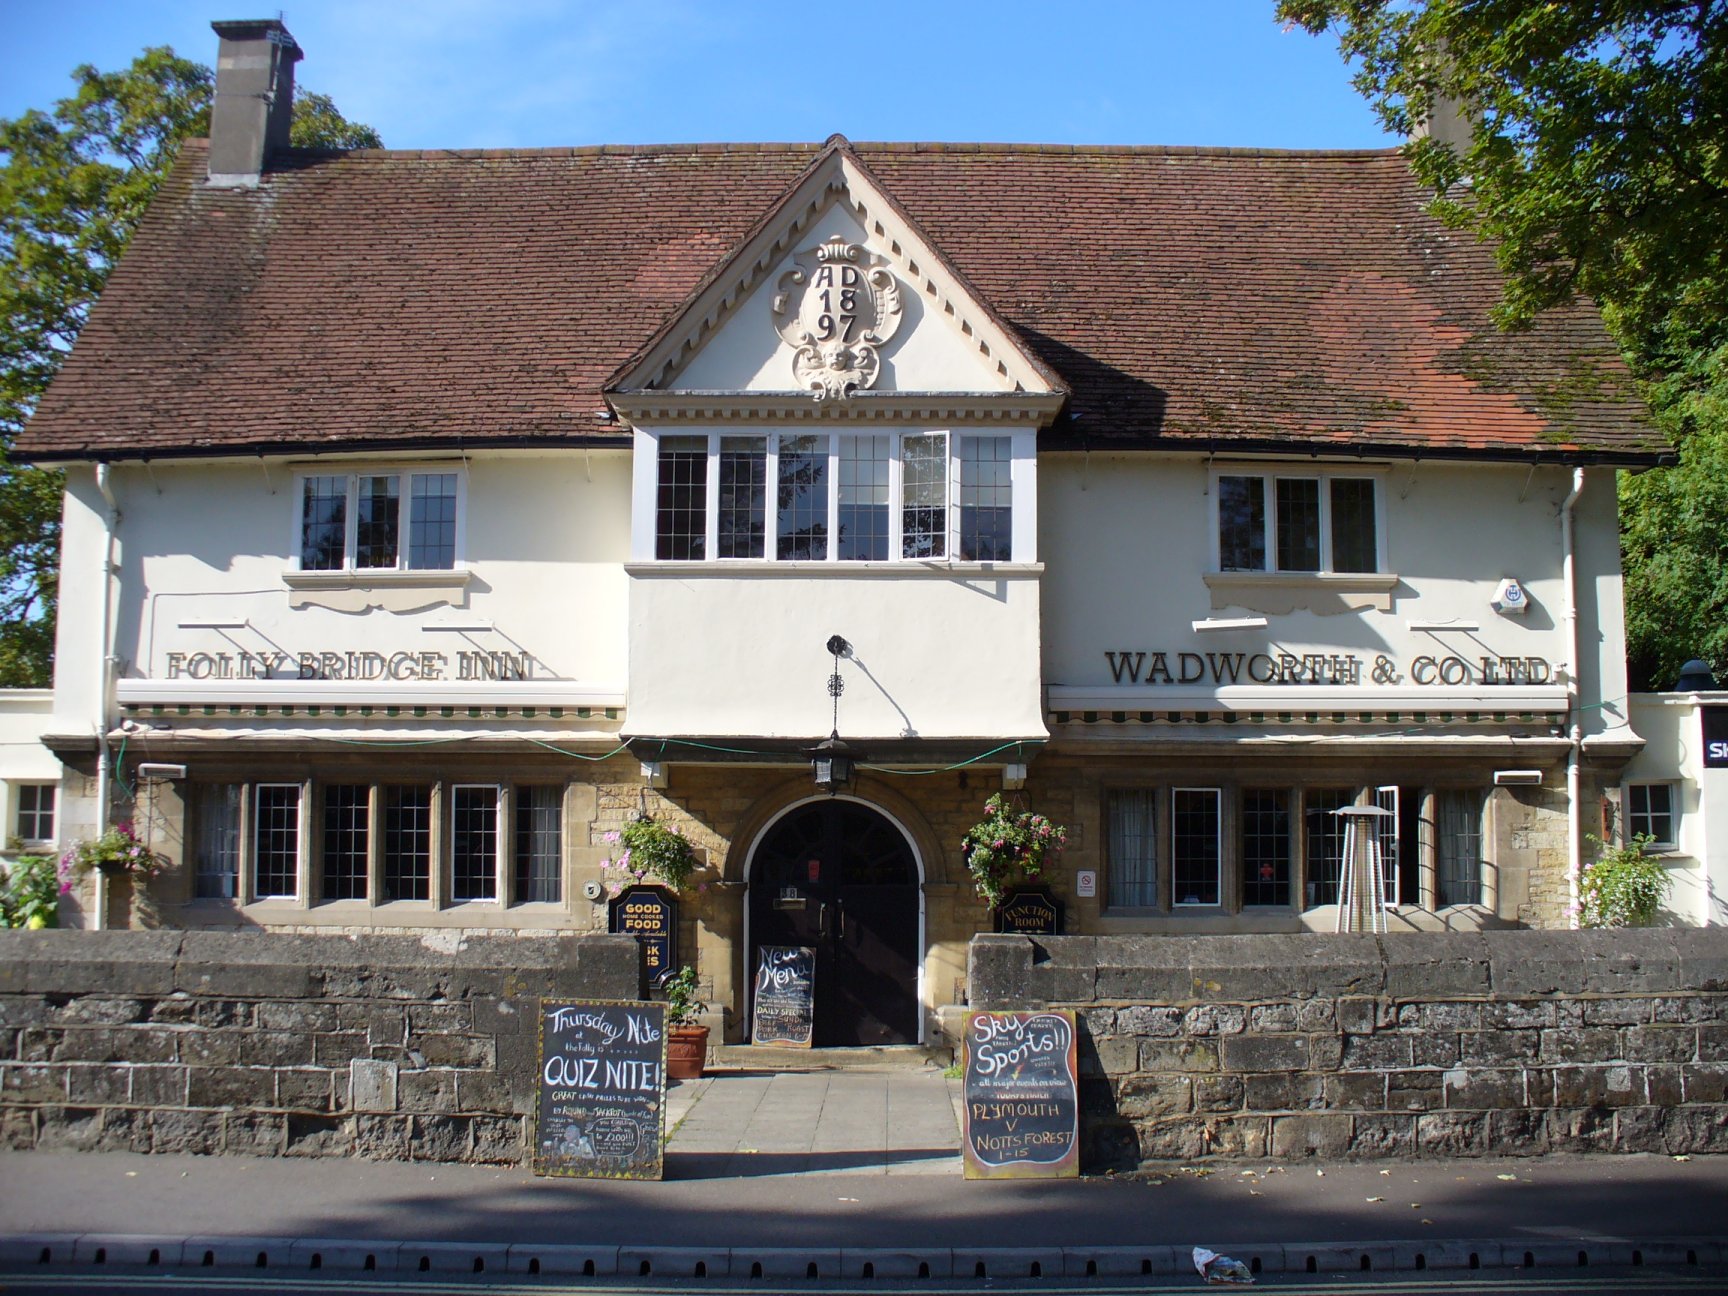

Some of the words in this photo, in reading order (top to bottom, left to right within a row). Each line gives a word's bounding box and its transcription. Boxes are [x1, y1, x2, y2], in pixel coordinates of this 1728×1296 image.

[165, 651, 282, 680] FOLLY
[297, 651, 441, 681] BRIDGE
[456, 650, 529, 681] INN
[1104, 651, 1356, 685] WADWORTH
[1371, 654, 1397, 685] &
[1410, 655, 1466, 686] CO
[625, 904, 661, 914] GOOD
[1005, 905, 1054, 921] FUNCTION
[626, 920, 661, 929] FOOD
[1015, 918, 1045, 927] ROOM
[760, 946, 798, 969] New
[758, 963, 810, 991] Menu
[757, 1006, 780, 1016] DAILY
[544, 1007, 625, 1045] Thursday
[626, 1013, 661, 1045] Nite
[974, 1015, 1025, 1042] Sky
[976, 1028, 1065, 1078] Sports!!
[544, 1055, 599, 1088] QUIZ
[604, 1059, 661, 1091] NITE!
[979, 1078, 991, 1087] all
[993, 1079, 1015, 1090] major
[551, 1091, 577, 1102] GREAT
[973, 1103, 1060, 1120] PLYMOUTH
[976, 1133, 1022, 1151] NOTTS
[1024, 1131, 1073, 1145] FOREST
[999, 1147, 1030, 1160] 1-15
